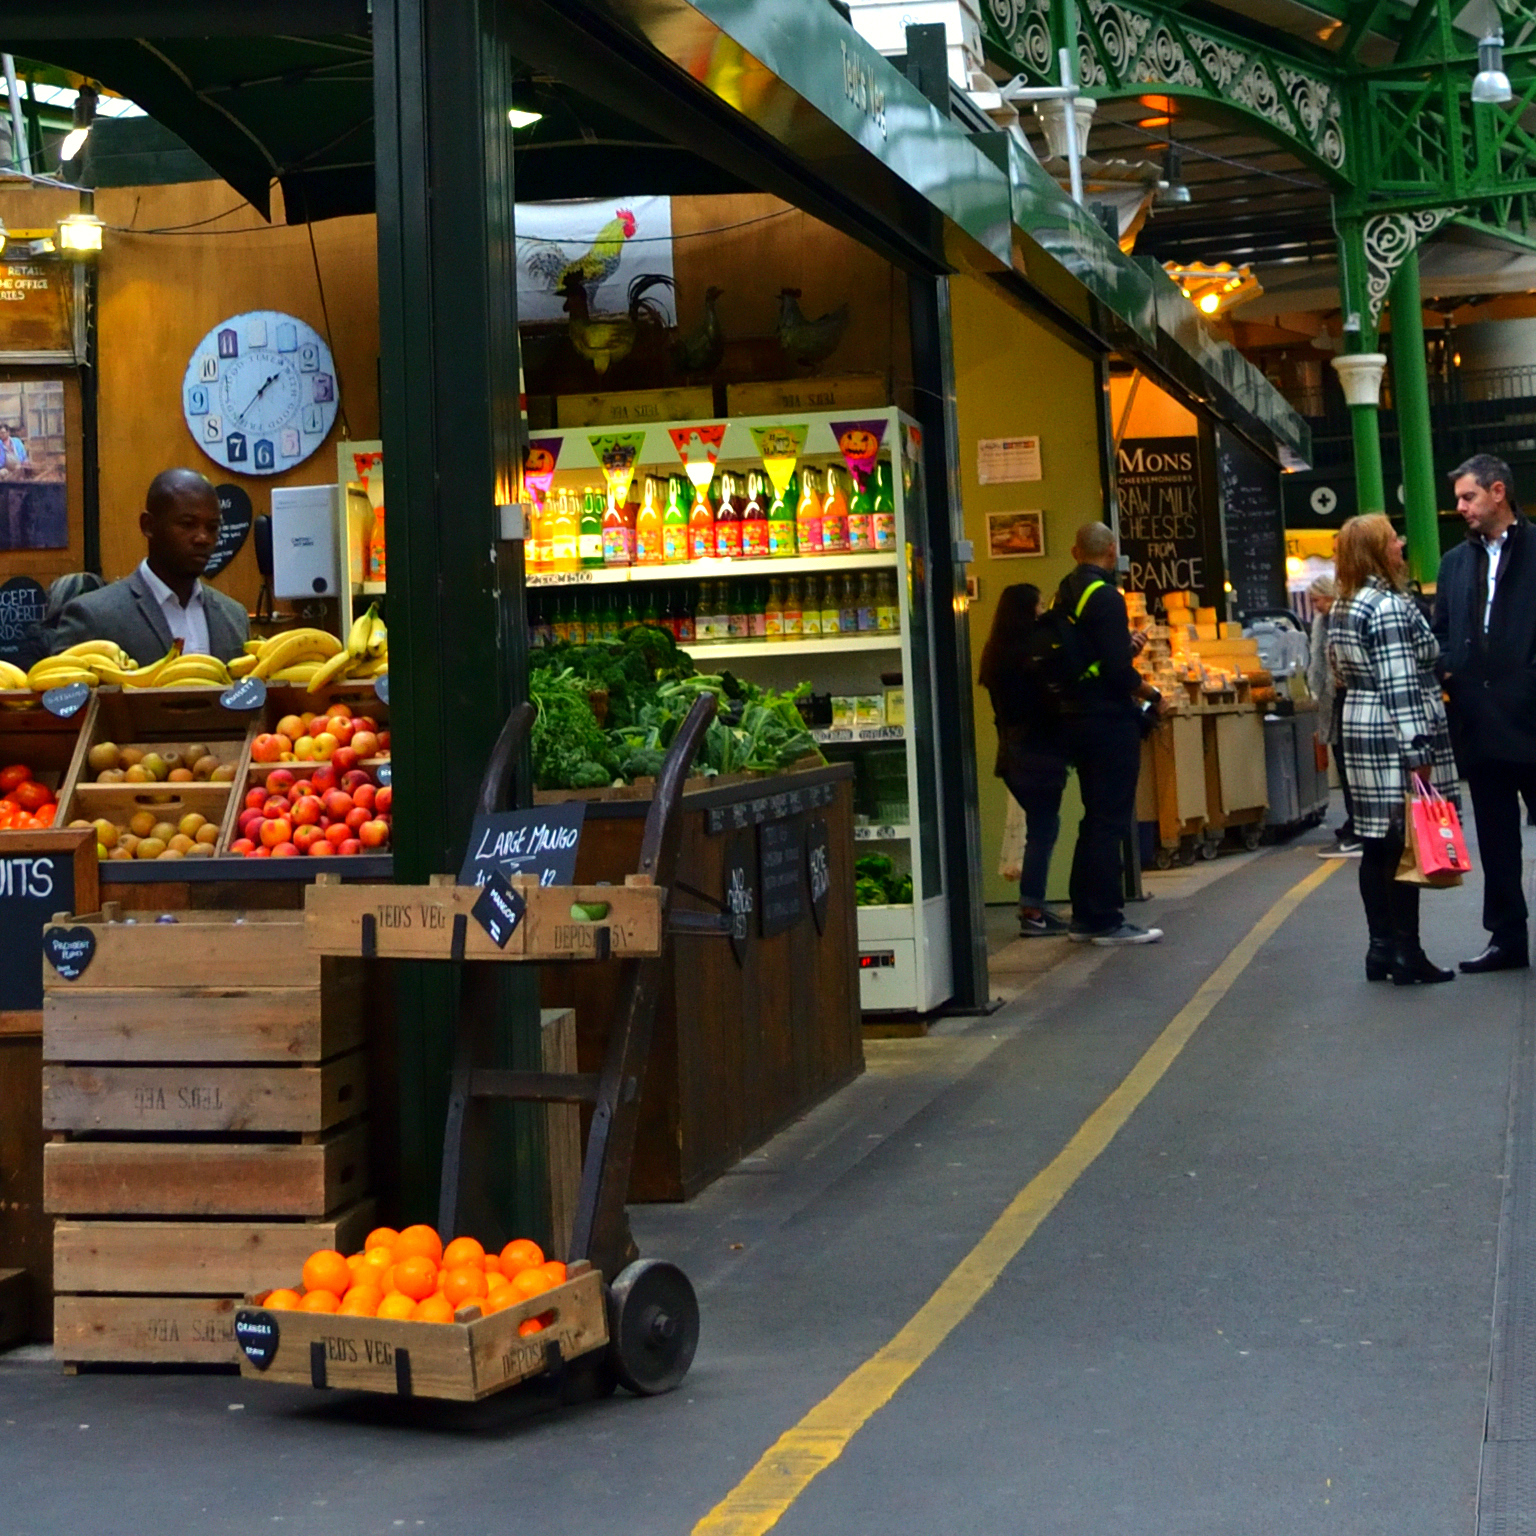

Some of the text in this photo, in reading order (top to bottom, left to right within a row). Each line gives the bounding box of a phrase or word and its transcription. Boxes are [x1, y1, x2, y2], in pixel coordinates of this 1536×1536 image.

[14, 279, 49, 290] OFFICE
[192, 390, 205, 410] 9
[207, 418, 219, 439] 8
[229, 438, 242, 458] 7
[257, 445, 270, 464] 6
[1118, 474, 1193, 485] CHEESEMONGERS
[1117, 485, 1199, 515] RAW MILK
[1118, 514, 1197, 540] CHEESES
[1147, 542, 1178, 559] FROM
[376, 904, 446, 930] TED'S VEG
[362, 1339, 393, 1365] VEG
